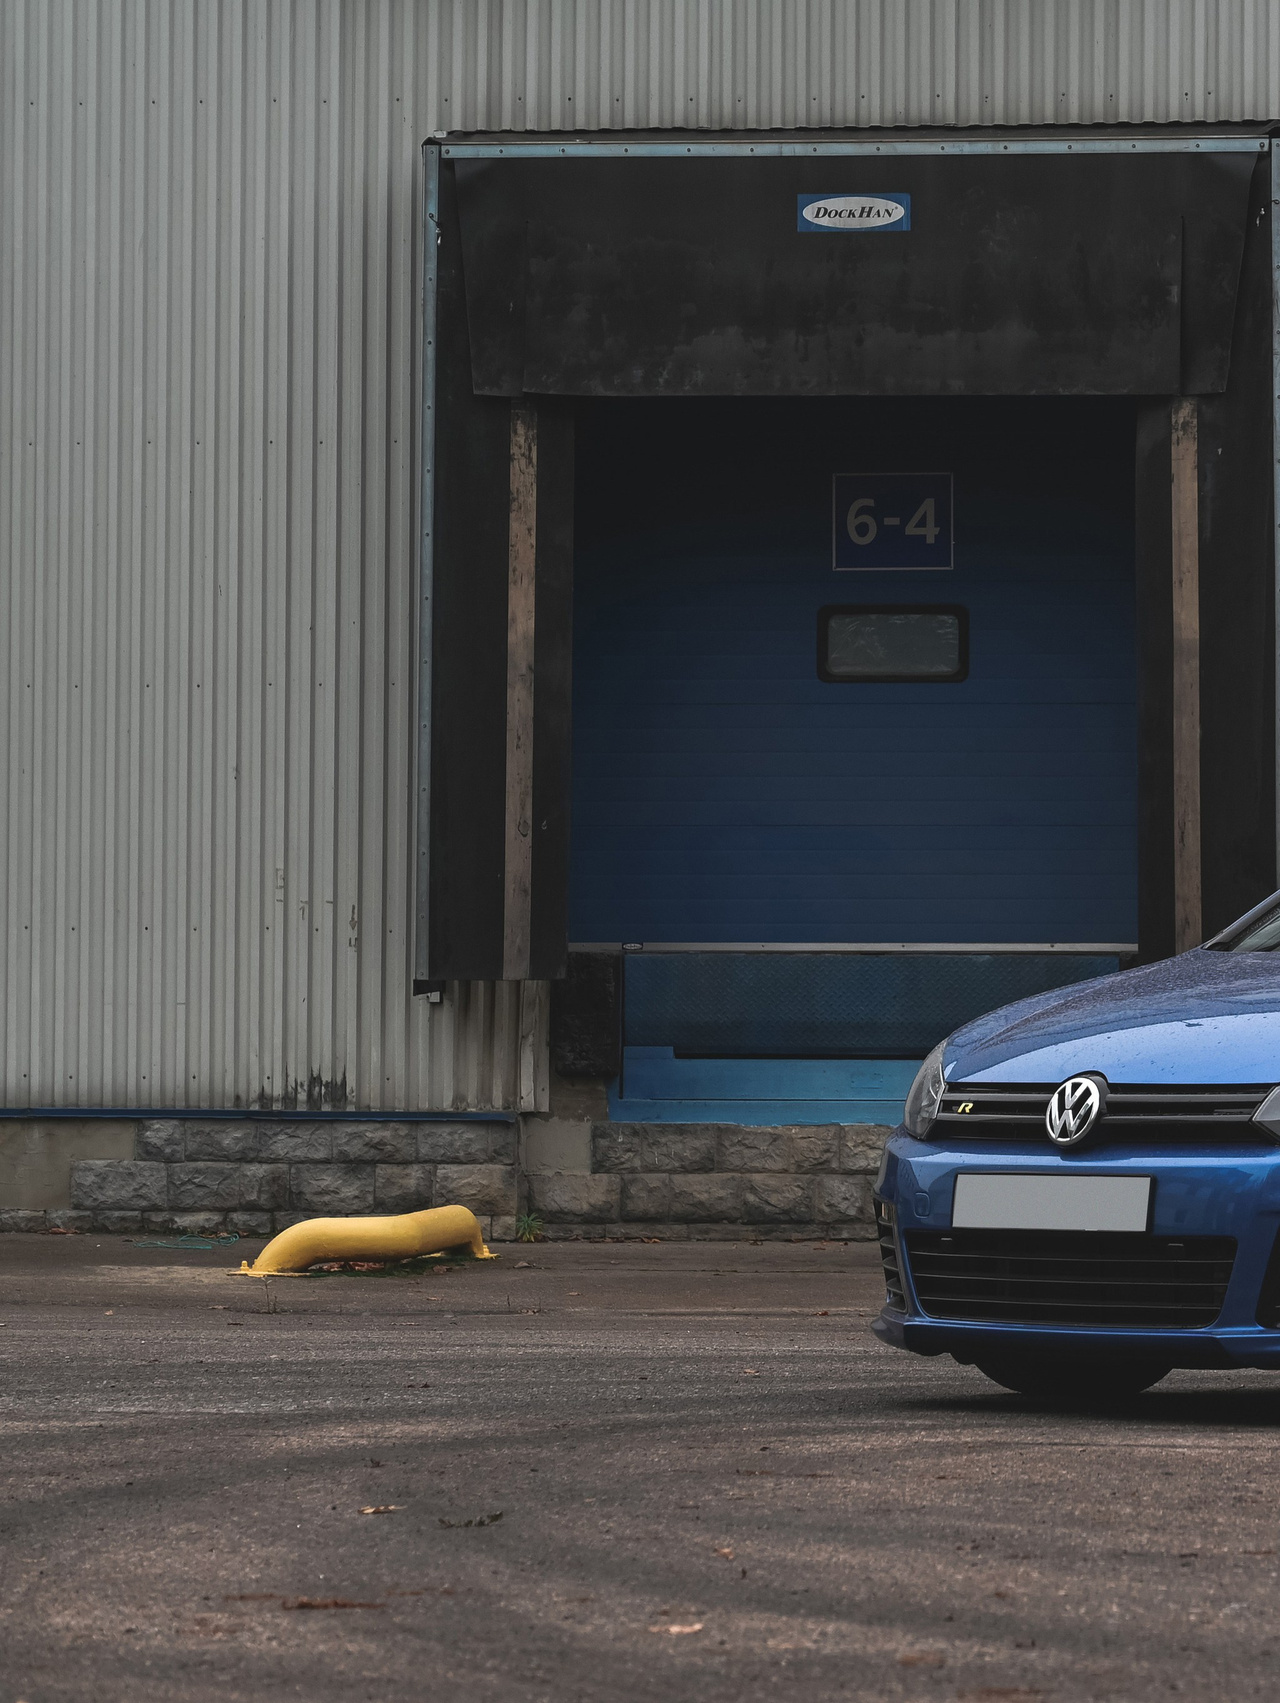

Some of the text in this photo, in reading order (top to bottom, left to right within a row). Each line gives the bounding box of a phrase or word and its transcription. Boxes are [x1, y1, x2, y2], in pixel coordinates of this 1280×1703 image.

[846, 498, 941, 545] 6-4
[957, 1102, 974, 1114] R
[1046, 1077, 1100, 1146] VW
